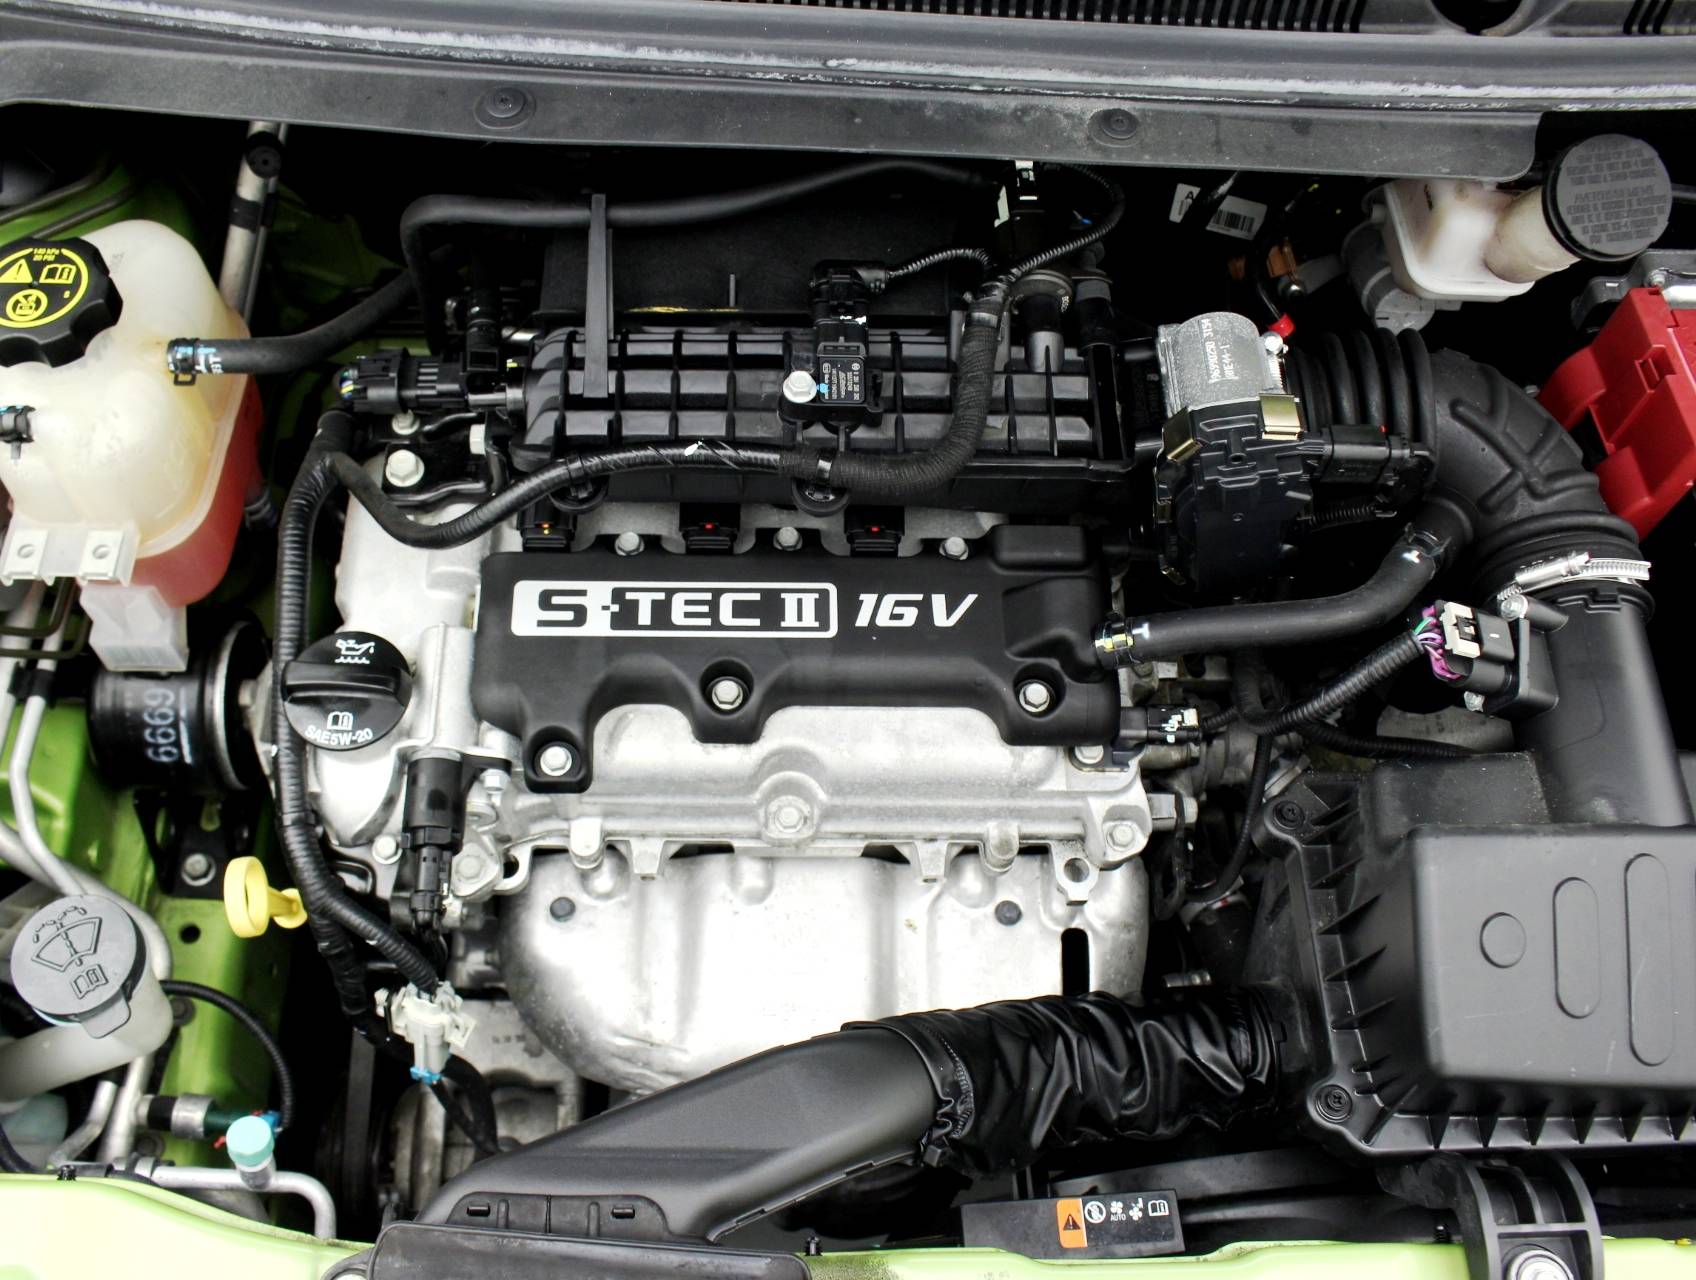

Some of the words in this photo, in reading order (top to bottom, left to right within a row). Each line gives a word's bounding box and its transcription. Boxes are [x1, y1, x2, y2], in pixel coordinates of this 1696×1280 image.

[537, 588, 761, 628] S-TEC
[780, 592, 820, 628] II
[854, 593, 978, 628] 16V
[1109, 1213, 1127, 1222] AUTO
